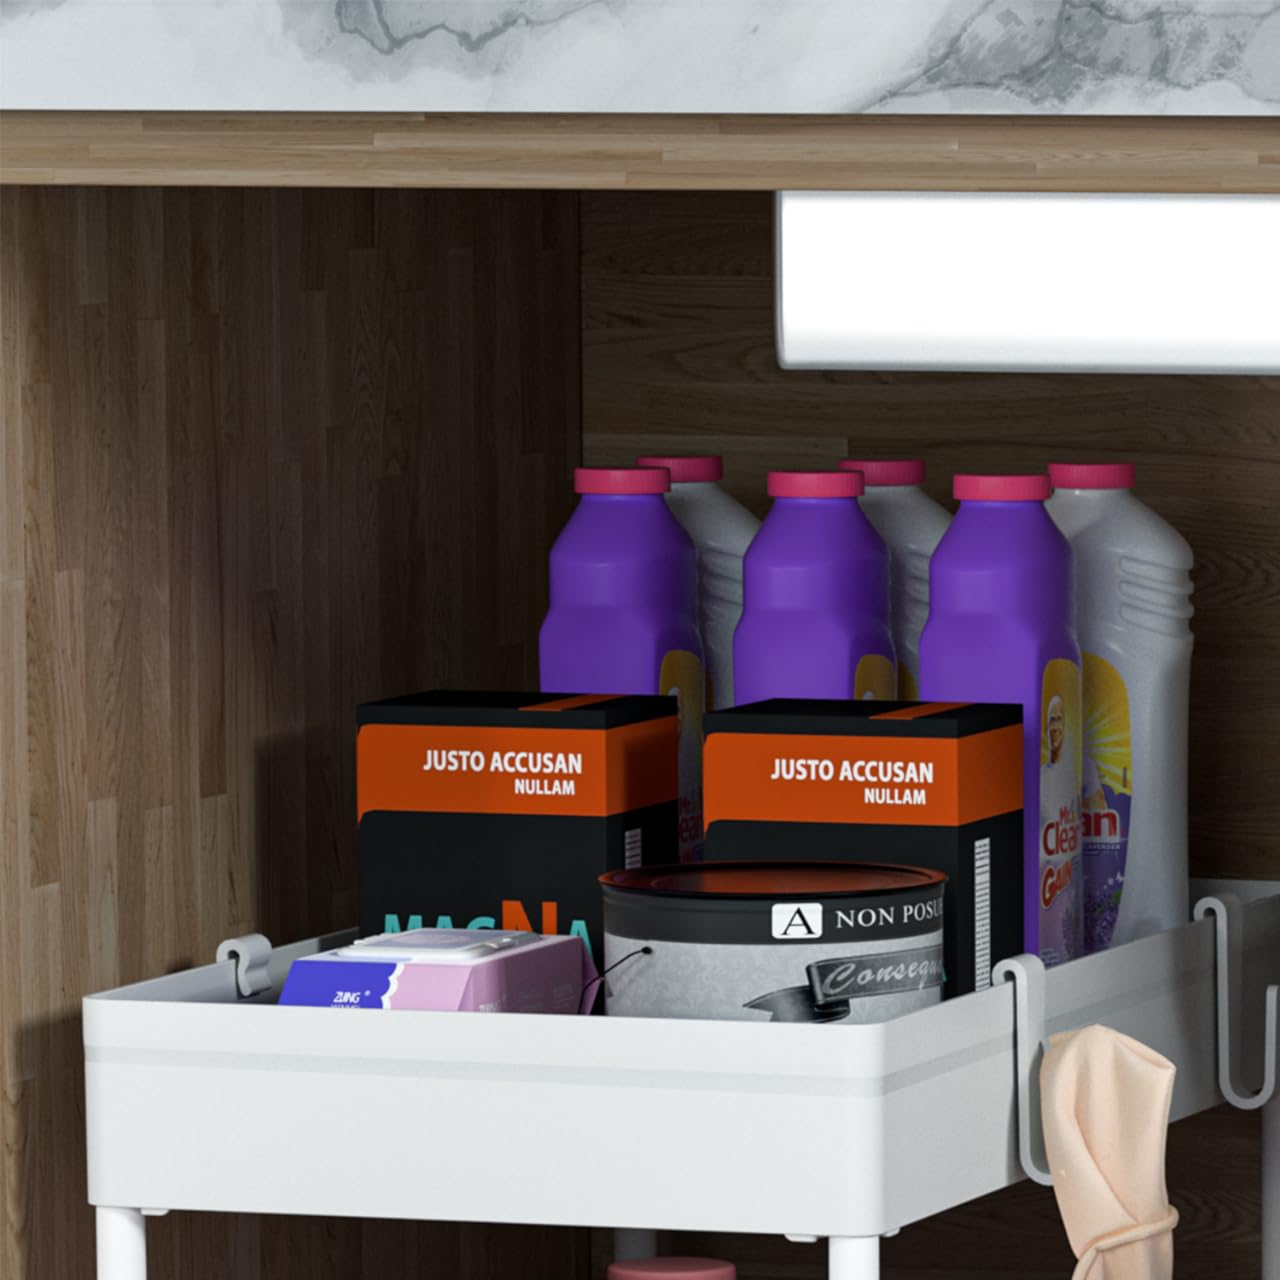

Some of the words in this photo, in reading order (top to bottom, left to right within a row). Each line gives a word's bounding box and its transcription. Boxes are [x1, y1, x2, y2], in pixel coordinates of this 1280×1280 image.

[423, 749, 485, 773] JUSTO
[490, 752, 583, 775] ACCUSAN
[770, 758, 835, 782] JUSTO
[839, 760, 934, 784] ACCUSAN
[514, 778, 576, 797] NULLAM
[864, 787, 927, 807] NULLAM
[779, 907, 817, 936] A
[835, 907, 895, 929] NON
